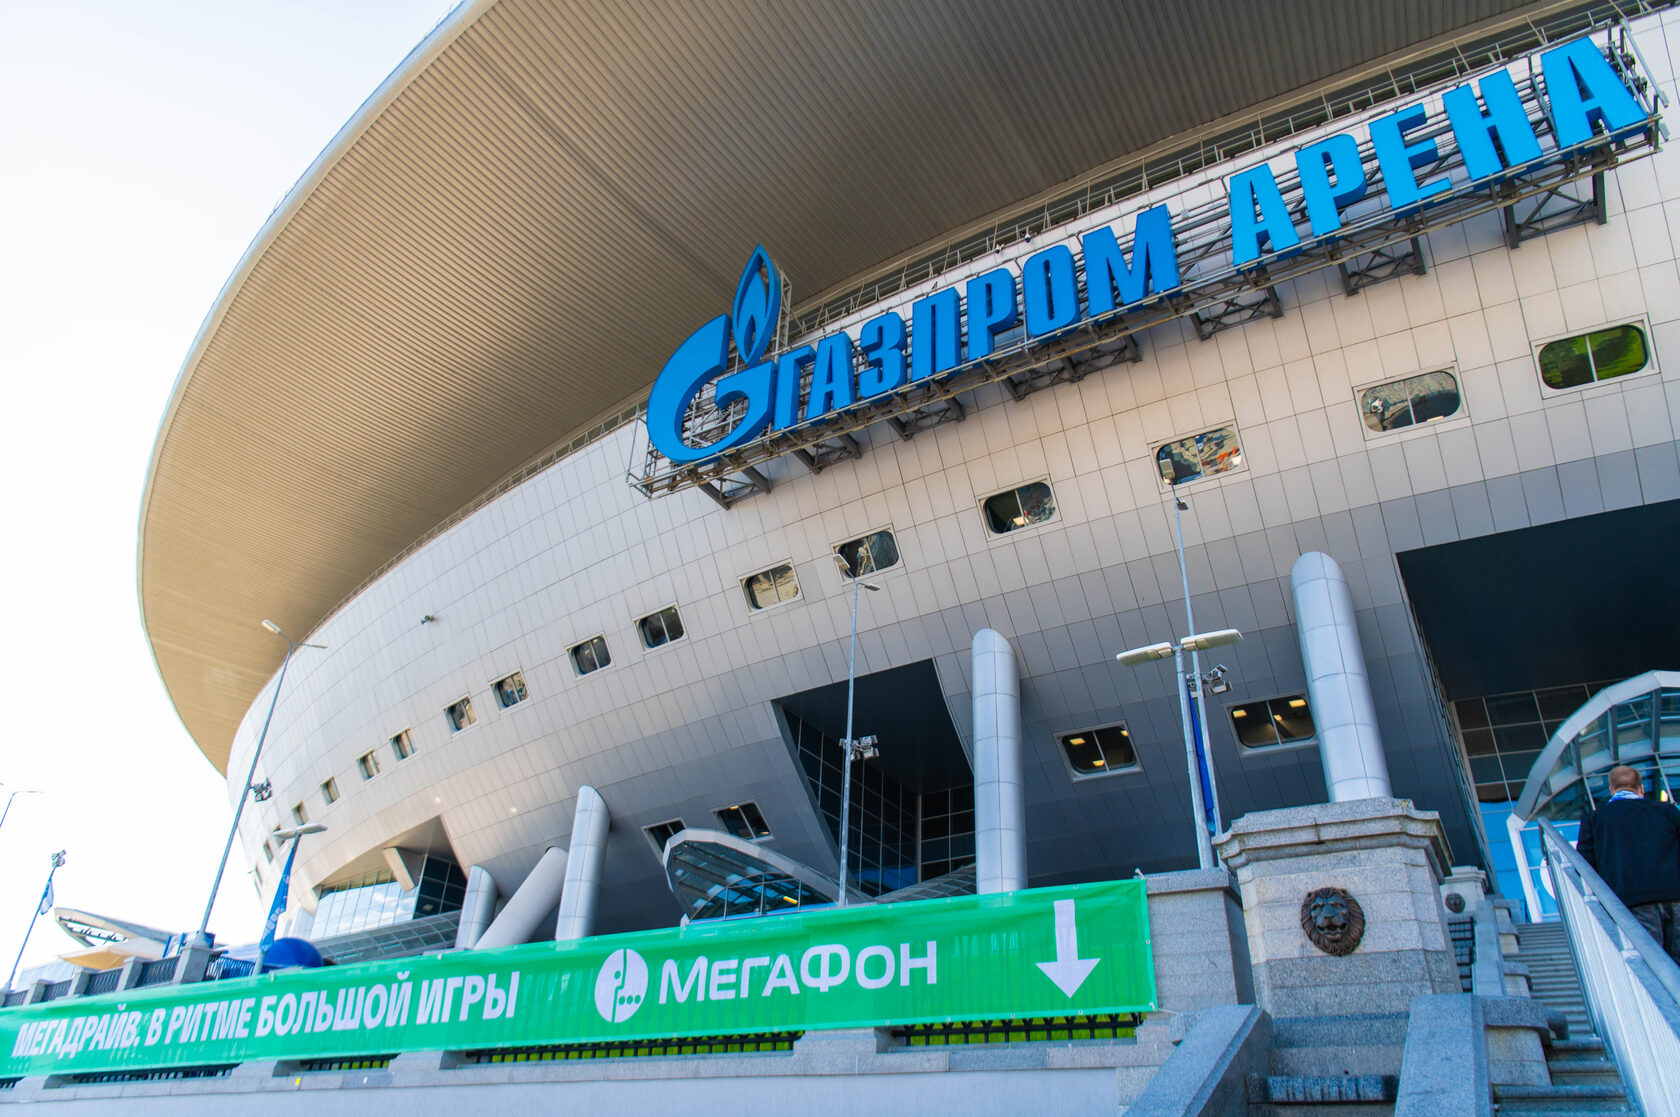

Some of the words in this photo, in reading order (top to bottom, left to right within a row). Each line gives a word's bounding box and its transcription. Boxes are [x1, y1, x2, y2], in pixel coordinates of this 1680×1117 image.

[773, 204, 1182, 433] ГАЗПРОМ
[1229, 36, 1649, 273] АРЕНА
[12, 1003, 141, 1059] МЕГАДРАЙВ.
[145, 1009, 165, 1046] В
[166, 996, 252, 1044] РИТМЕ
[259, 970, 412, 1036] БОЛЬШОЙ
[417, 970, 521, 1024] ИГРЫ
[659, 940, 937, 1005] МЕГАФОН
